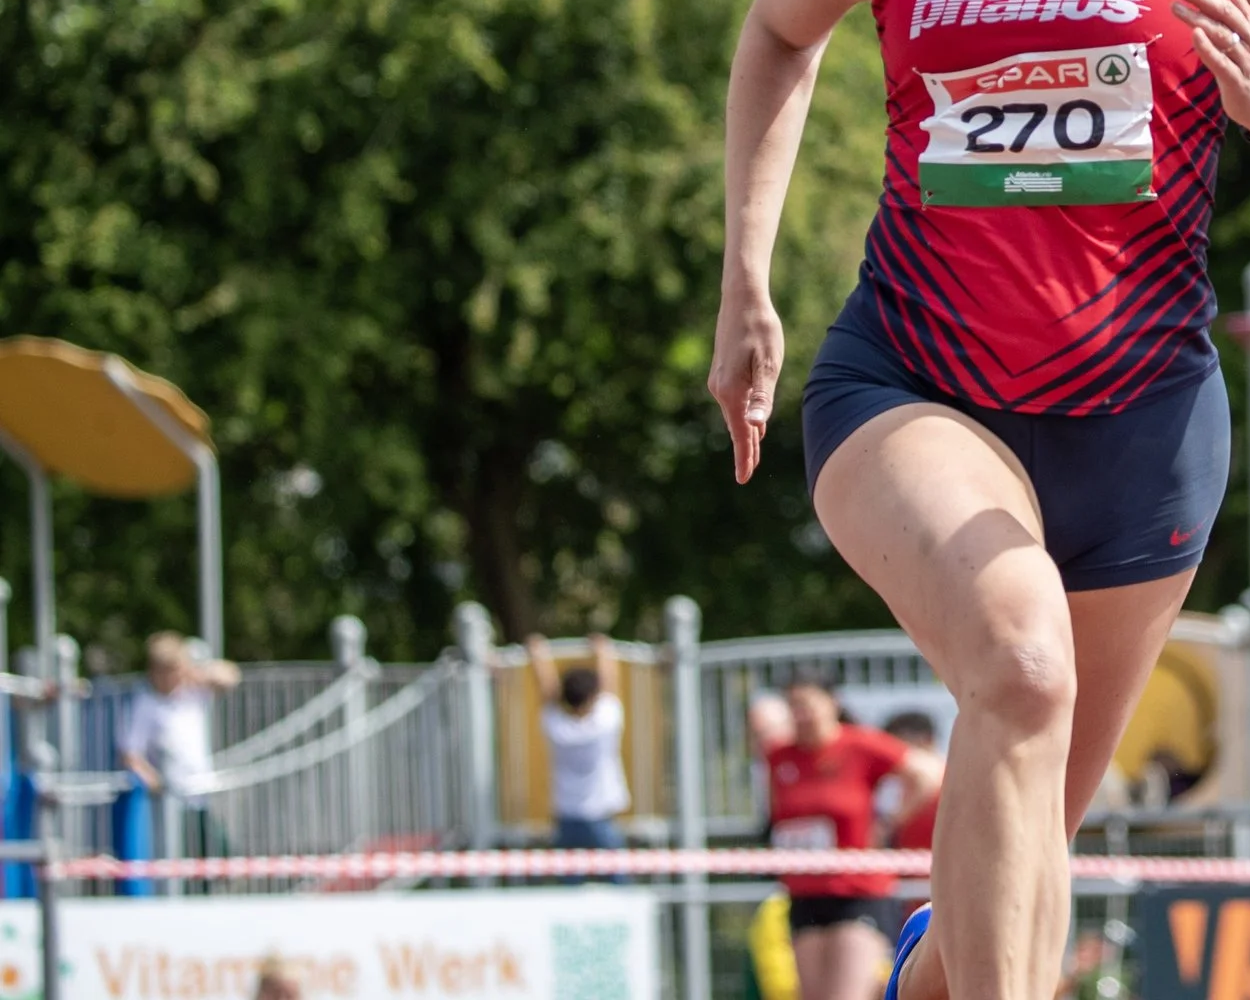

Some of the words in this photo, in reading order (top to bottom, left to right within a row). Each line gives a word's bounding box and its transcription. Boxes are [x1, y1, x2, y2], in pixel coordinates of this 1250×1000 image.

[976, 65, 1085, 89] SPAR
[961, 99, 1104, 152] 270
[376, 936, 525, 992] Werk
